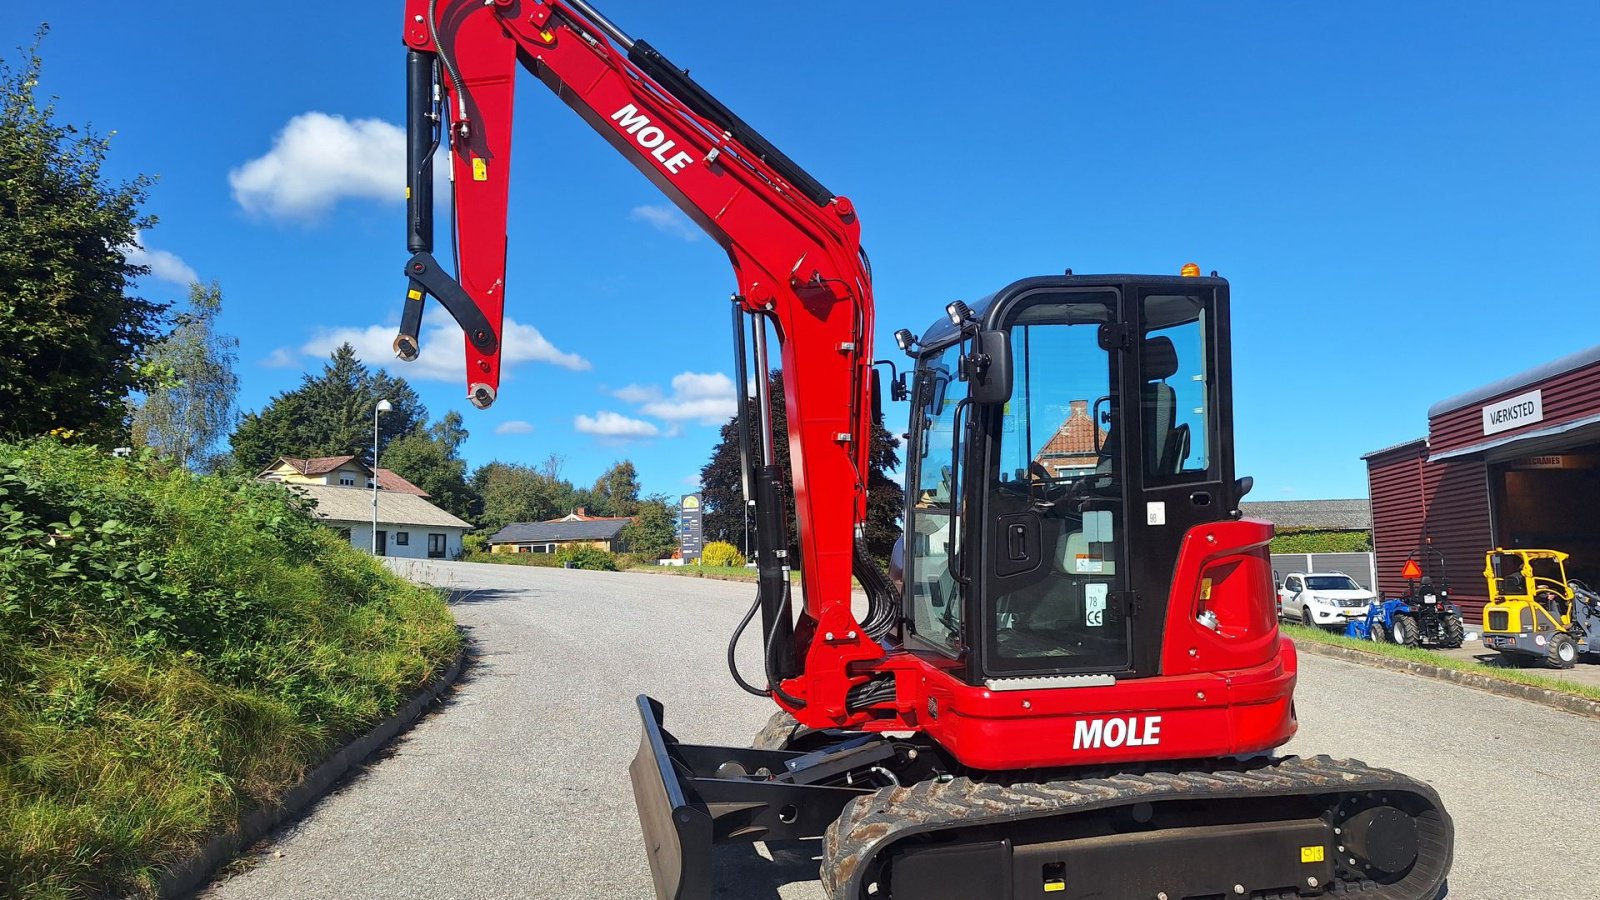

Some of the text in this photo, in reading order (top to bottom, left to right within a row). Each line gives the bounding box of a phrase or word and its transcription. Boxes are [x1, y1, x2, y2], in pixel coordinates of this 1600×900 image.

[611, 103, 694, 174] MOLE
[1490, 401, 1535, 425] VÆRKSTED
[1089, 596, 1098, 607] 78
[1073, 716, 1162, 750] MOLE
